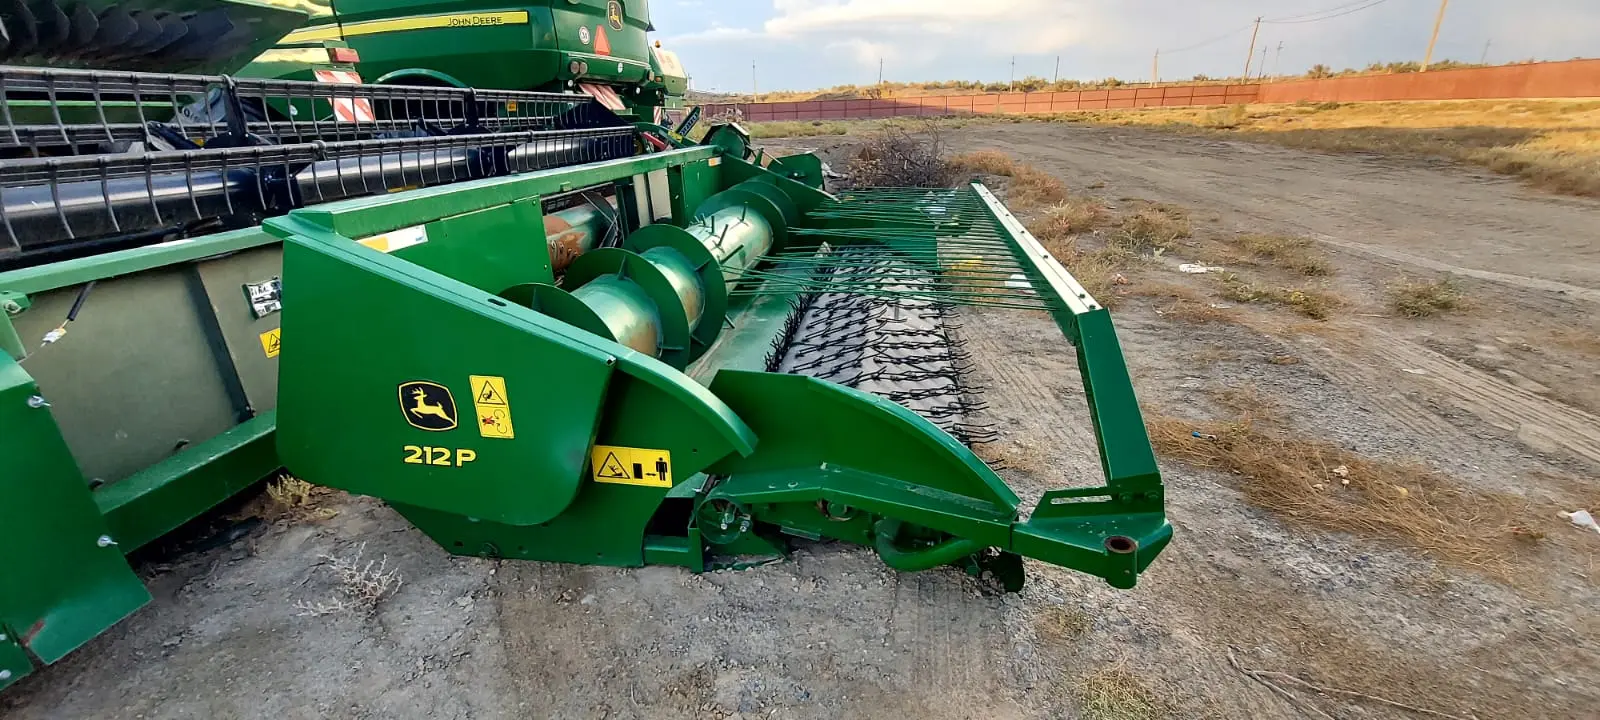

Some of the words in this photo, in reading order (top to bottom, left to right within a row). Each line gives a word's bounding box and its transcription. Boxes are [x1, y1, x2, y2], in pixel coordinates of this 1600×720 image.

[448, 17, 471, 26] JOHN
[473, 16, 503, 25] DEERE
[404, 445, 451, 466] 212
[456, 448, 476, 467] P
